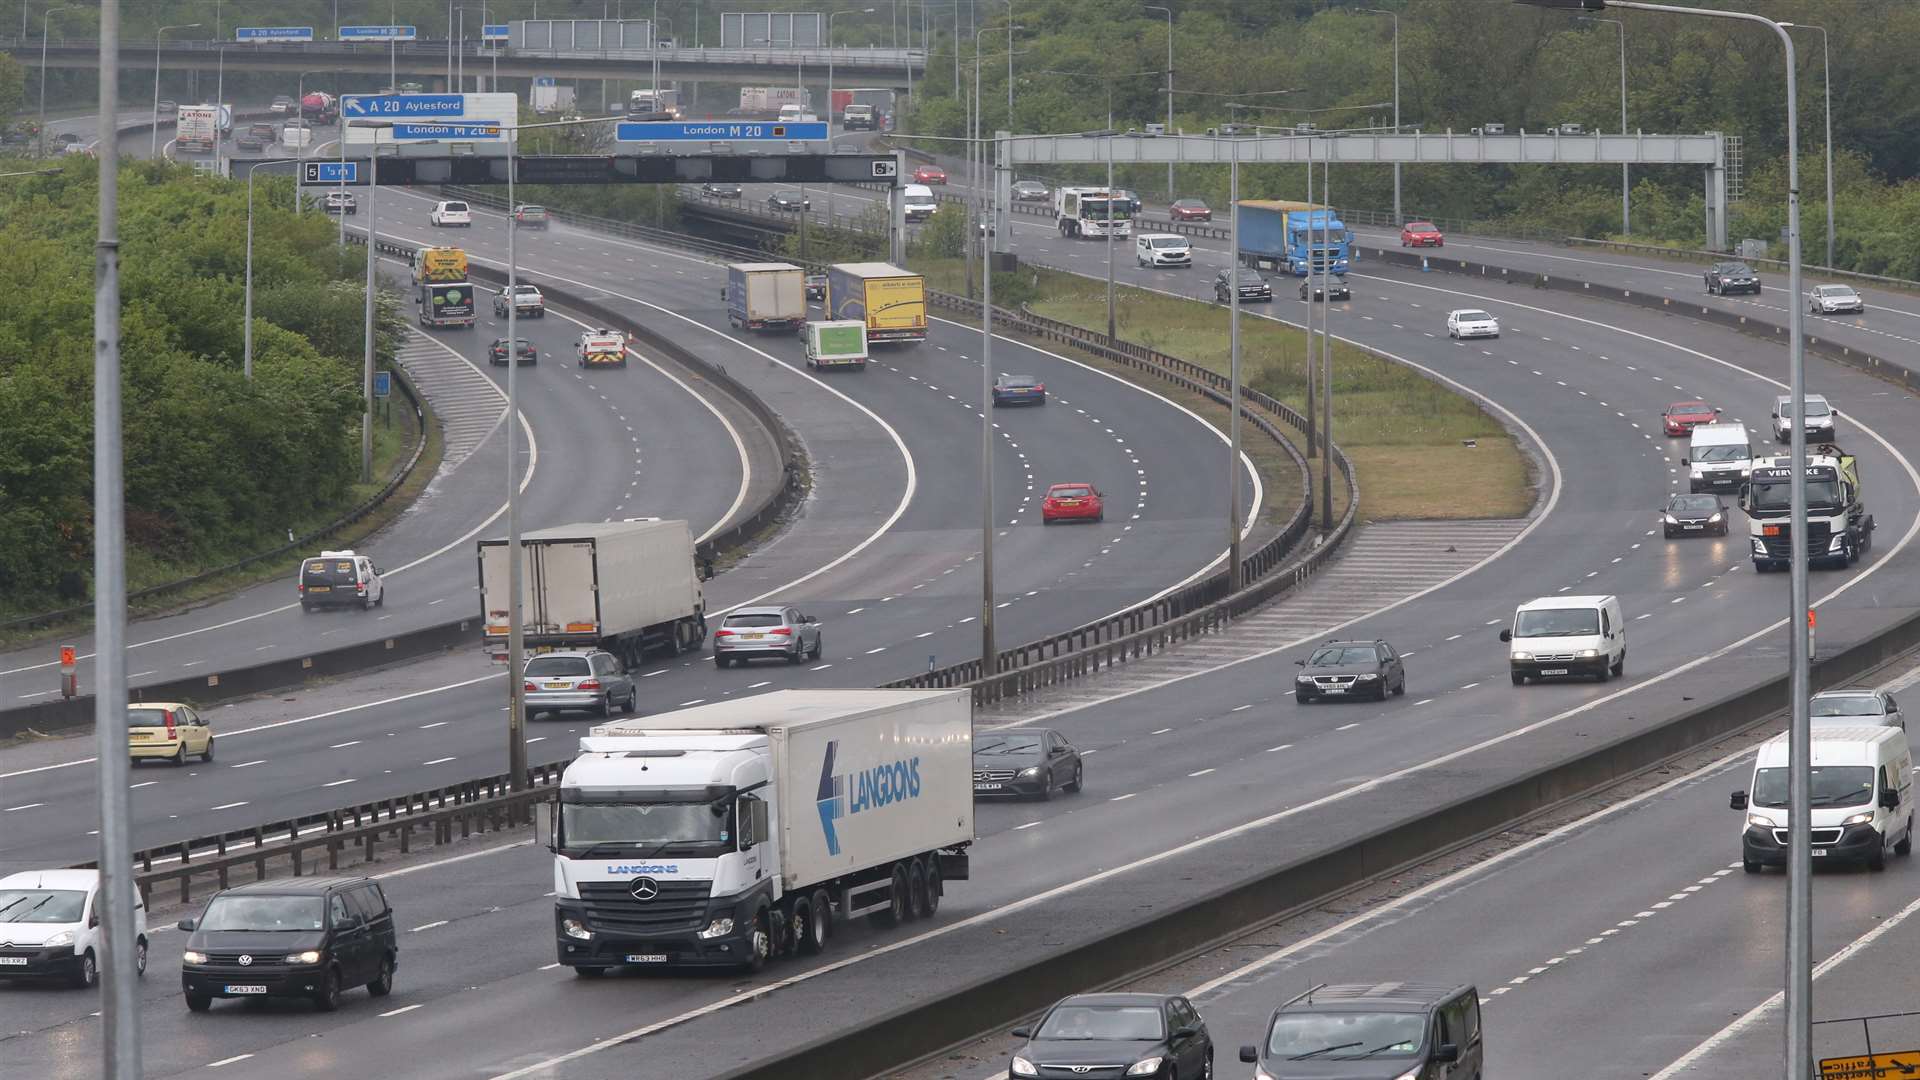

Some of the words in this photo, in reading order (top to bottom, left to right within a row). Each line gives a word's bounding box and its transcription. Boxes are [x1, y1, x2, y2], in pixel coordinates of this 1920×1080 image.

[370, 101, 379, 112] A
[384, 101, 400, 112] 20
[405, 101, 460, 112] Aylesford
[407, 125, 449, 134] London
[454, 127, 465, 135] M
[470, 127, 487, 135] 20
[683, 126, 725, 135] London
[729, 125, 741, 137] M
[745, 125, 762, 137] 20
[309, 168, 317, 177] 5
[849, 756, 920, 814] LANGDONS
[607, 864, 679, 874] LANGDONS
